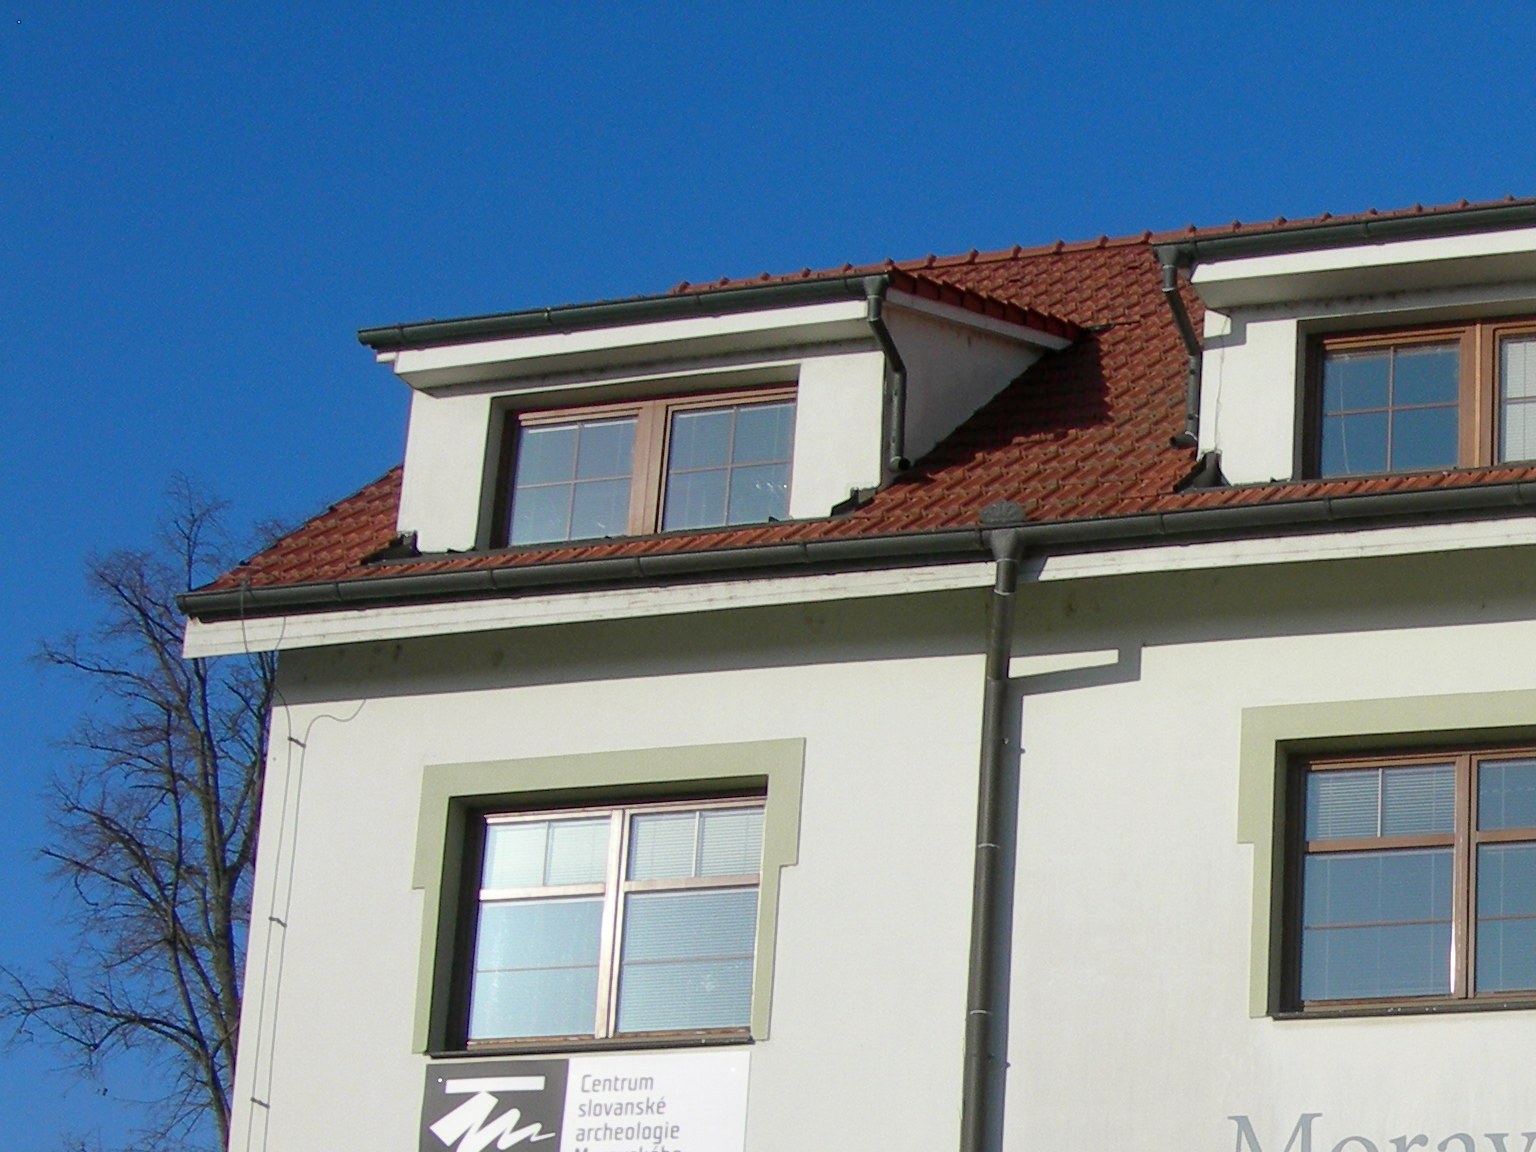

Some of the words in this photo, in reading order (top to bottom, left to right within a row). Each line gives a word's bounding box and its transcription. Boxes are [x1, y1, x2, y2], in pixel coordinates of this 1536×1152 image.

[581, 1074, 654, 1093] Centrum
[578, 1096, 667, 1118] slovanské
[575, 1121, 680, 1145] archeologie
